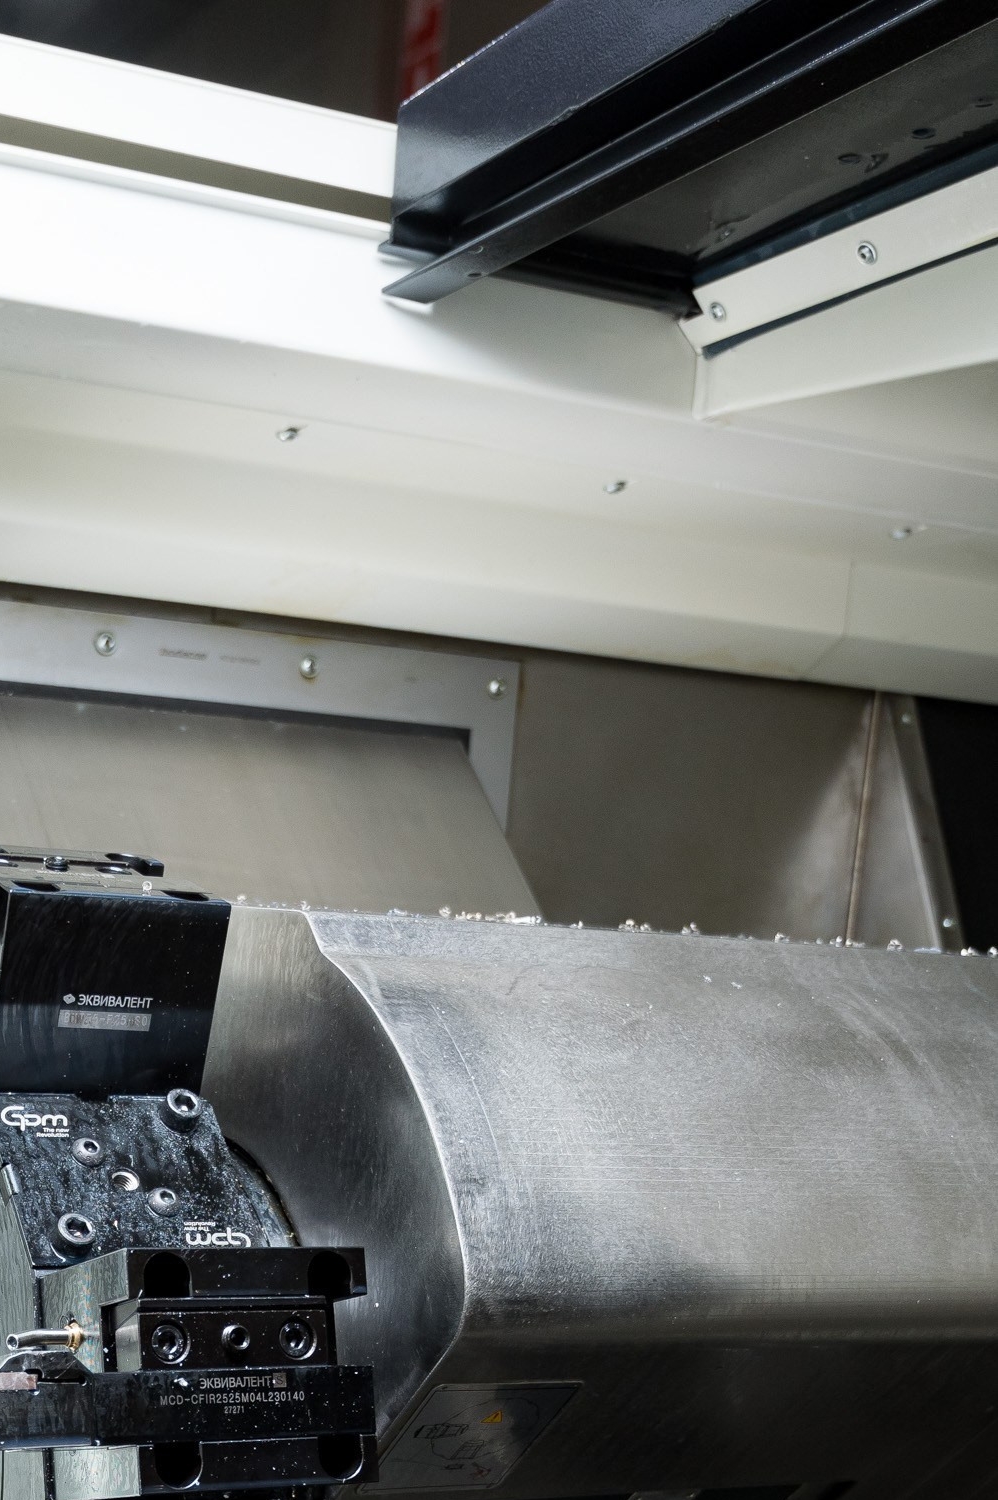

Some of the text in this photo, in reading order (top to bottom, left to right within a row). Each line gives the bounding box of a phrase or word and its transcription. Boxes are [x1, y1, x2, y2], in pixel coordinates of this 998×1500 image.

[77, 994, 153, 1009] ЭКВИВАЛЕНТ
[199, 1375, 272, 1389] ЭКВИВАЛЕНТ
[160, 1391, 305, 1406] MCD-CFIR2525M04L230140
[224, 1405, 245, 1414] 27271
